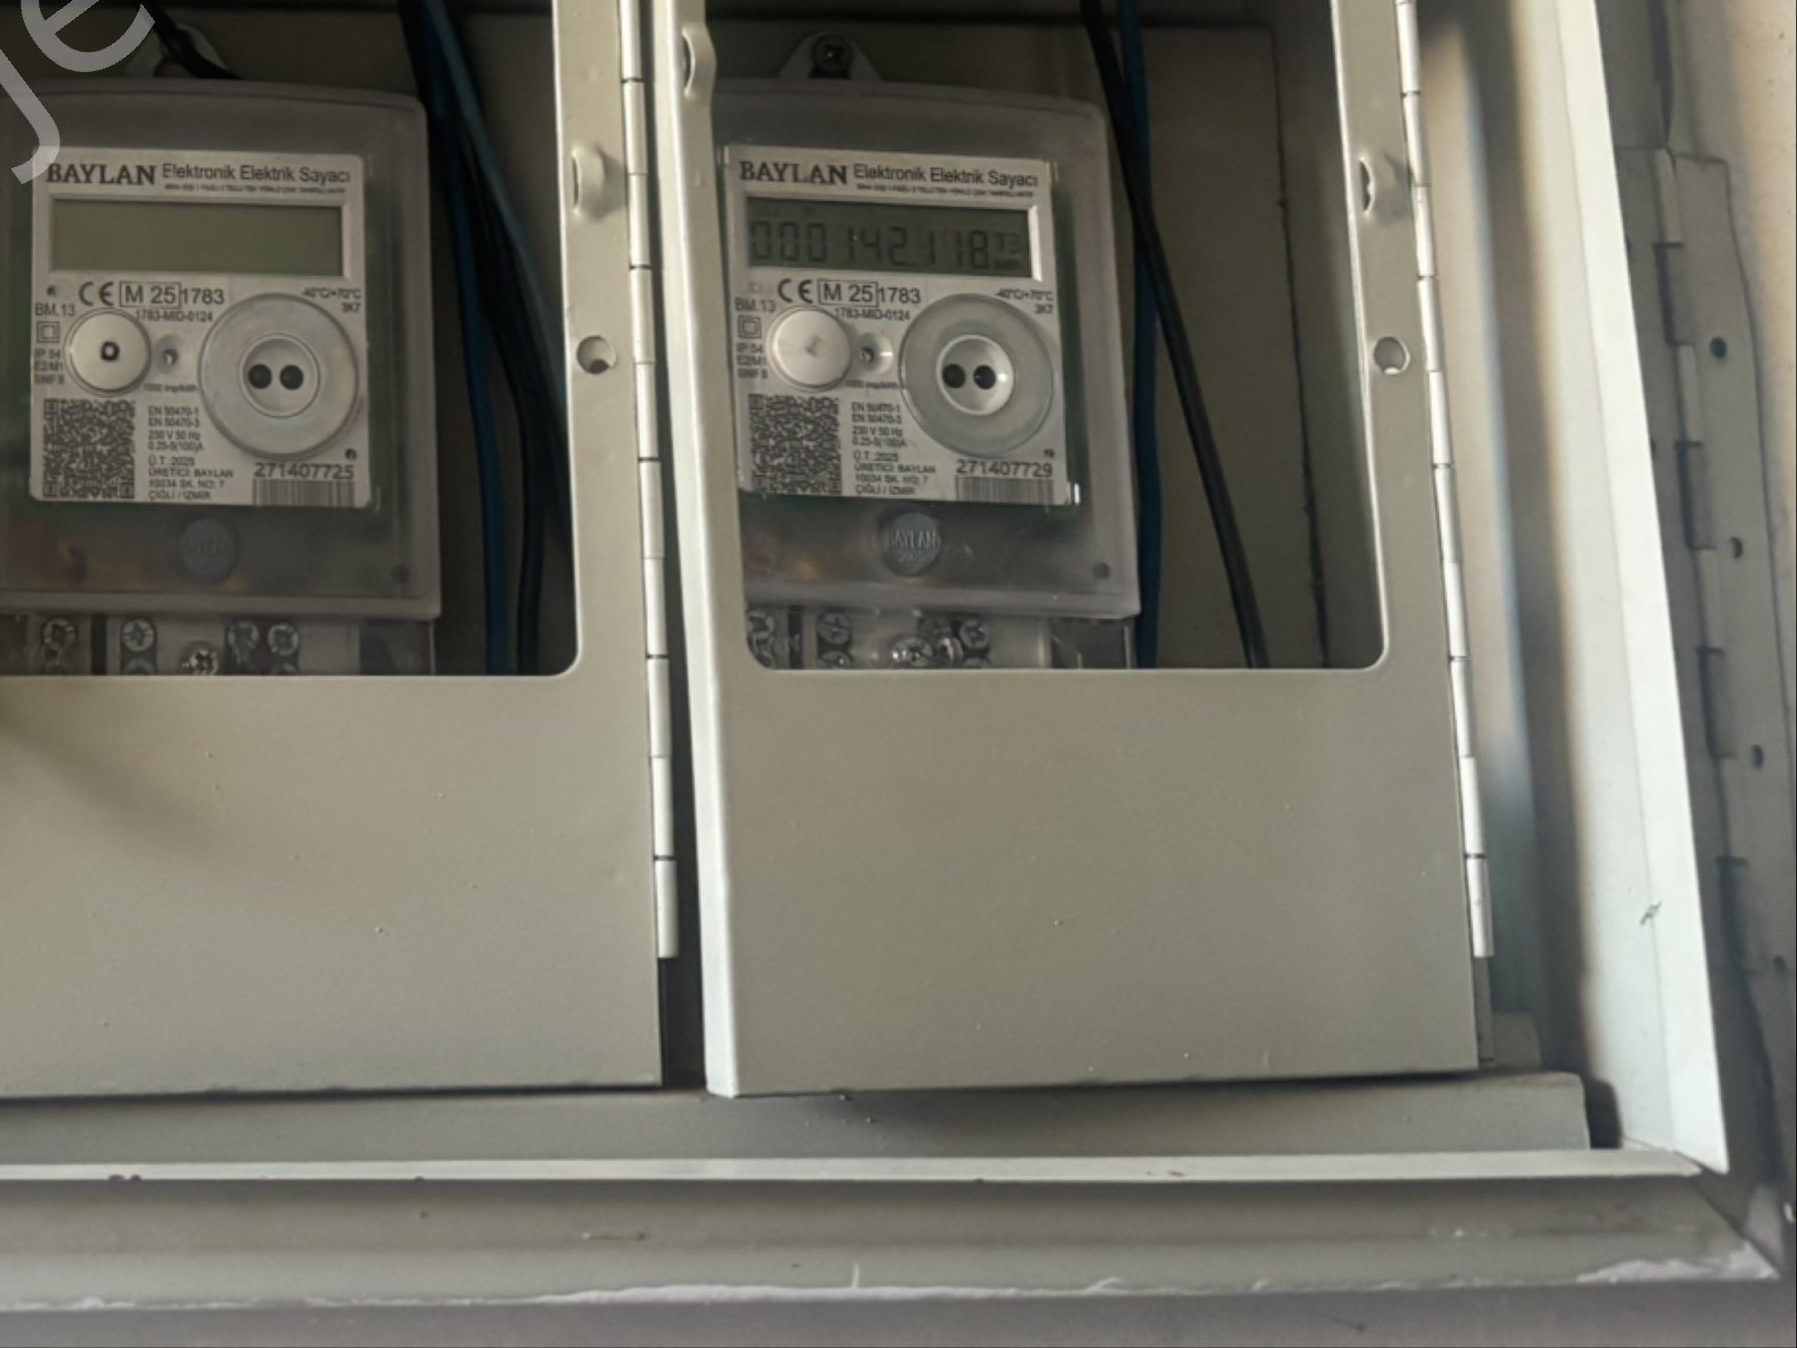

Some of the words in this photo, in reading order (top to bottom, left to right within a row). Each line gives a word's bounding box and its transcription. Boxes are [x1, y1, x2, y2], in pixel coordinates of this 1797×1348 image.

[47, 163, 157, 186] BAYLAN
[161, 163, 236, 181] Elektronik
[240, 164, 295, 182] Elektrik
[738, 160, 849, 186] BAYLAN
[853, 163, 927, 182] Elektronik
[930, 166, 984, 184] Elektrik
[181, 286, 226, 306] 1783
[878, 285, 922, 305] 1783
[253, 460, 356, 480] 271407725
[955, 458, 1053, 478] 271407729
